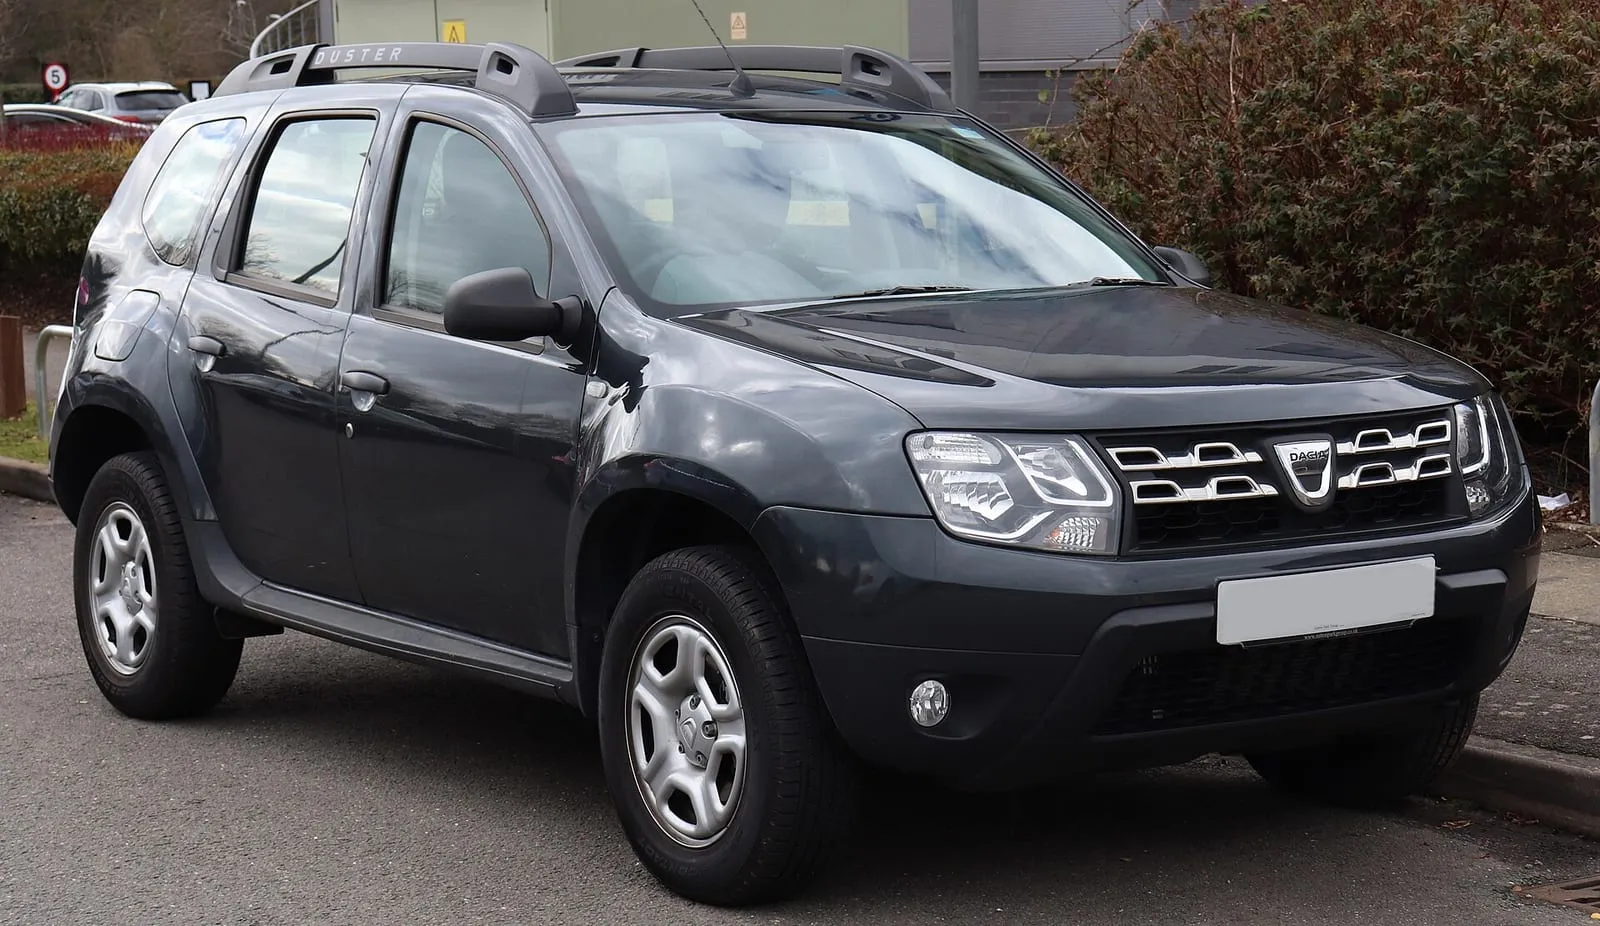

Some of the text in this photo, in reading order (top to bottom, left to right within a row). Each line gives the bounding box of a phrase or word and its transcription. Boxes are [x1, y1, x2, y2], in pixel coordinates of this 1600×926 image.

[314, 47, 402, 65] DUSTER
[51, 70, 60, 85] 5
[1289, 450, 1328, 462] DACIA
